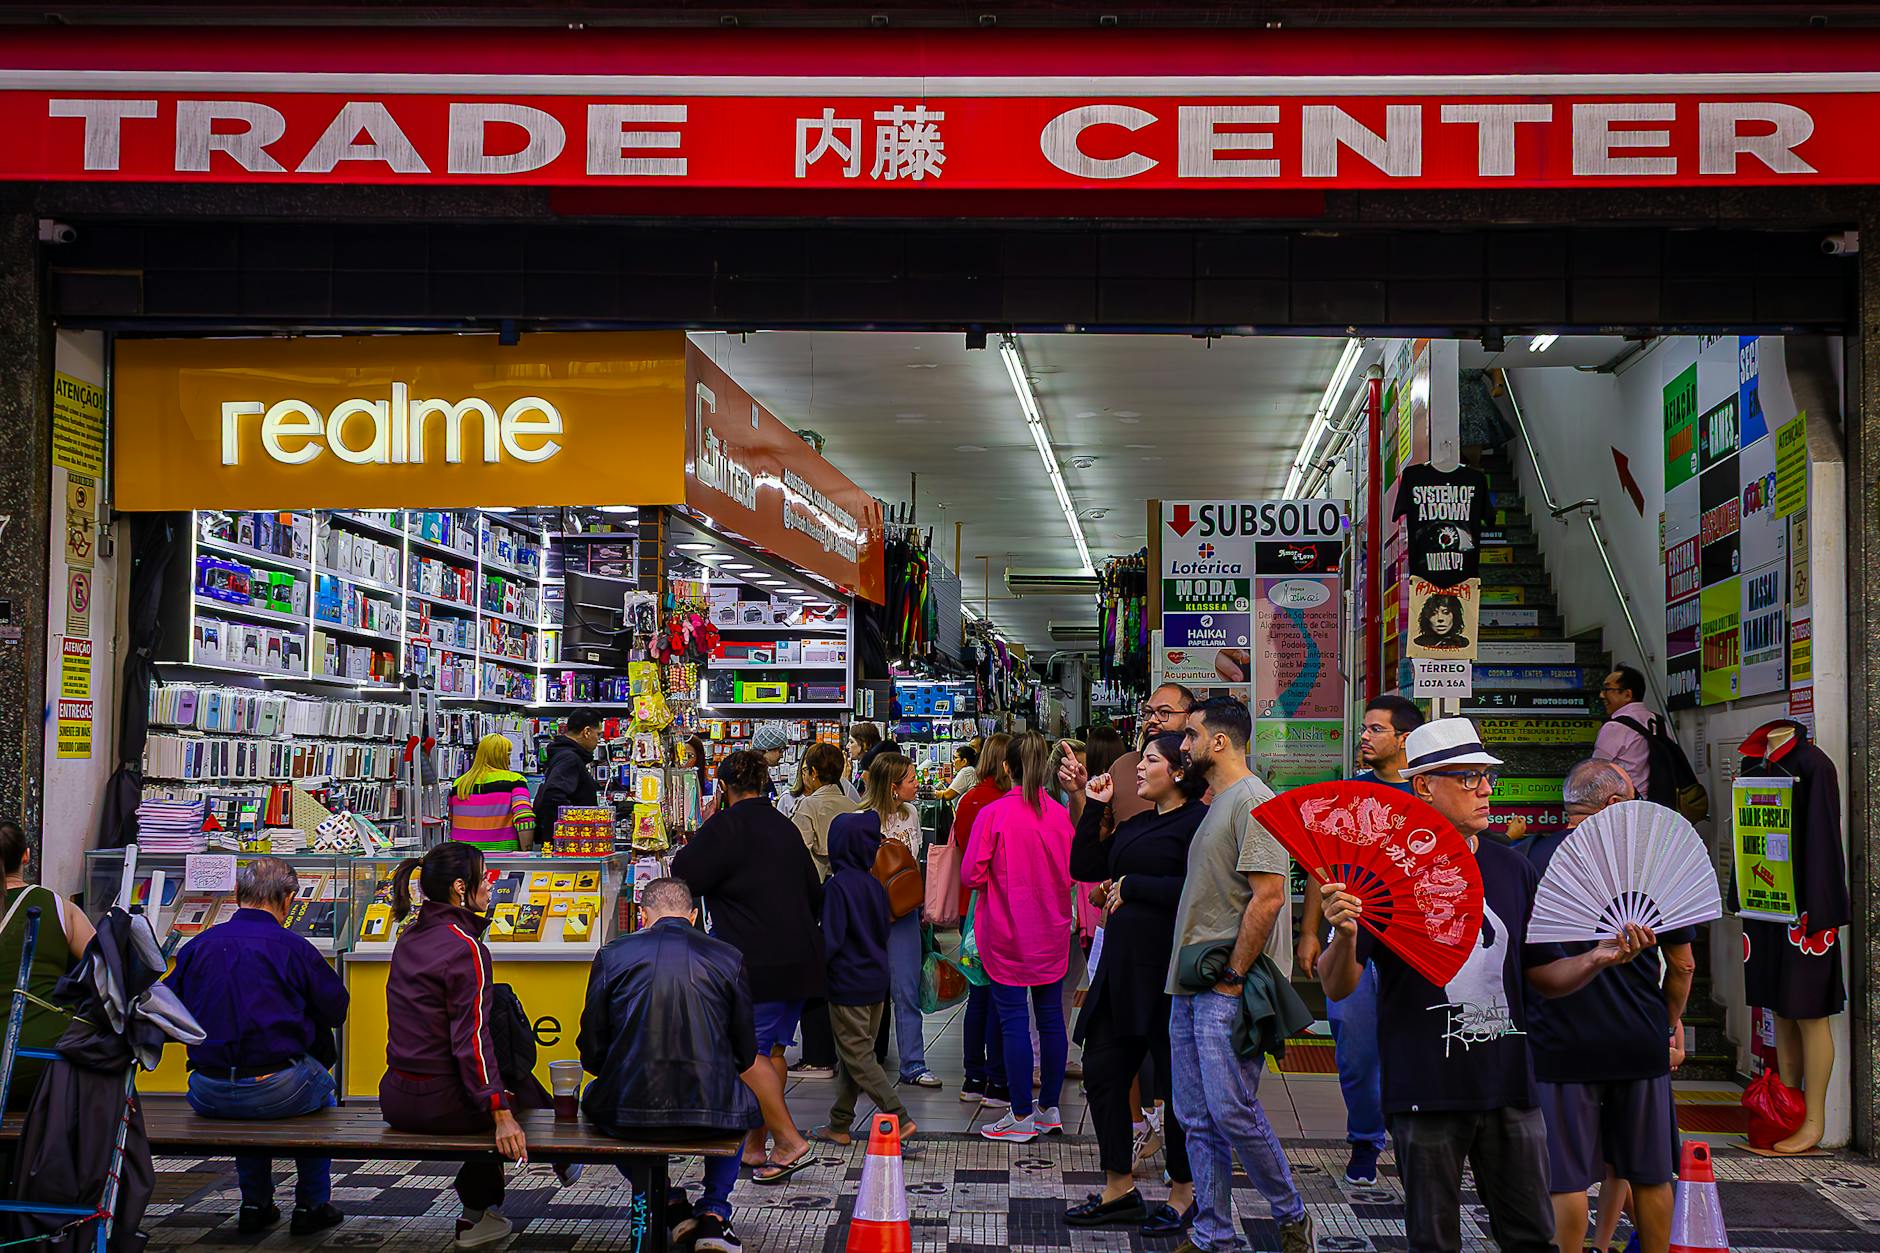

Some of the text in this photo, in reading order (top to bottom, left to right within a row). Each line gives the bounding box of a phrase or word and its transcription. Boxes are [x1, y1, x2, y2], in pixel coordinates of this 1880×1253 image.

[48, 99, 689, 177] TRADE
[795, 105, 948, 181] 内藤
[1040, 101, 1819, 180] CENTER
[55, 378, 104, 409] ATENÇÃO!
[220, 381, 564, 466] realme
[1709, 403, 1734, 459] GAMES
[1412, 484, 1476, 505] SYSTEM OF
[1418, 503, 1471, 521] A DOWN
[1199, 503, 1340, 537] SUBSOLO
[1278, 549, 1298, 557] Amor
[1171, 560, 1242, 574] Lotérica
[1426, 552, 1464, 571] WAKE UP!
[1176, 580, 1237, 596] MODA
[1258, 611, 1282, 620] Design
[1261, 622, 1308, 630] Alongamento
[1187, 629, 1227, 639] HAIKAI
[1270, 632, 1301, 640] Limpeza
[1313, 631, 1329, 639] Pele
[64, 640, 92, 657] ATENÇÃO
[1281, 641, 1317, 650] Podologia
[1265, 651, 1301, 660] Drenagem
[1273, 660, 1326, 669] Quick Massage
[1419, 662, 1465, 673] TÉRREO
[1278, 680, 1321, 689] Reflexologia
[1419, 680, 1466, 688] LOJA 16A
[59, 703, 93, 719] ENTREGAS
[1524, 720, 1594, 728] AFIADOR
[1538, 810, 1558, 824] de
[1762, 808, 1790, 828] COSPLAY
